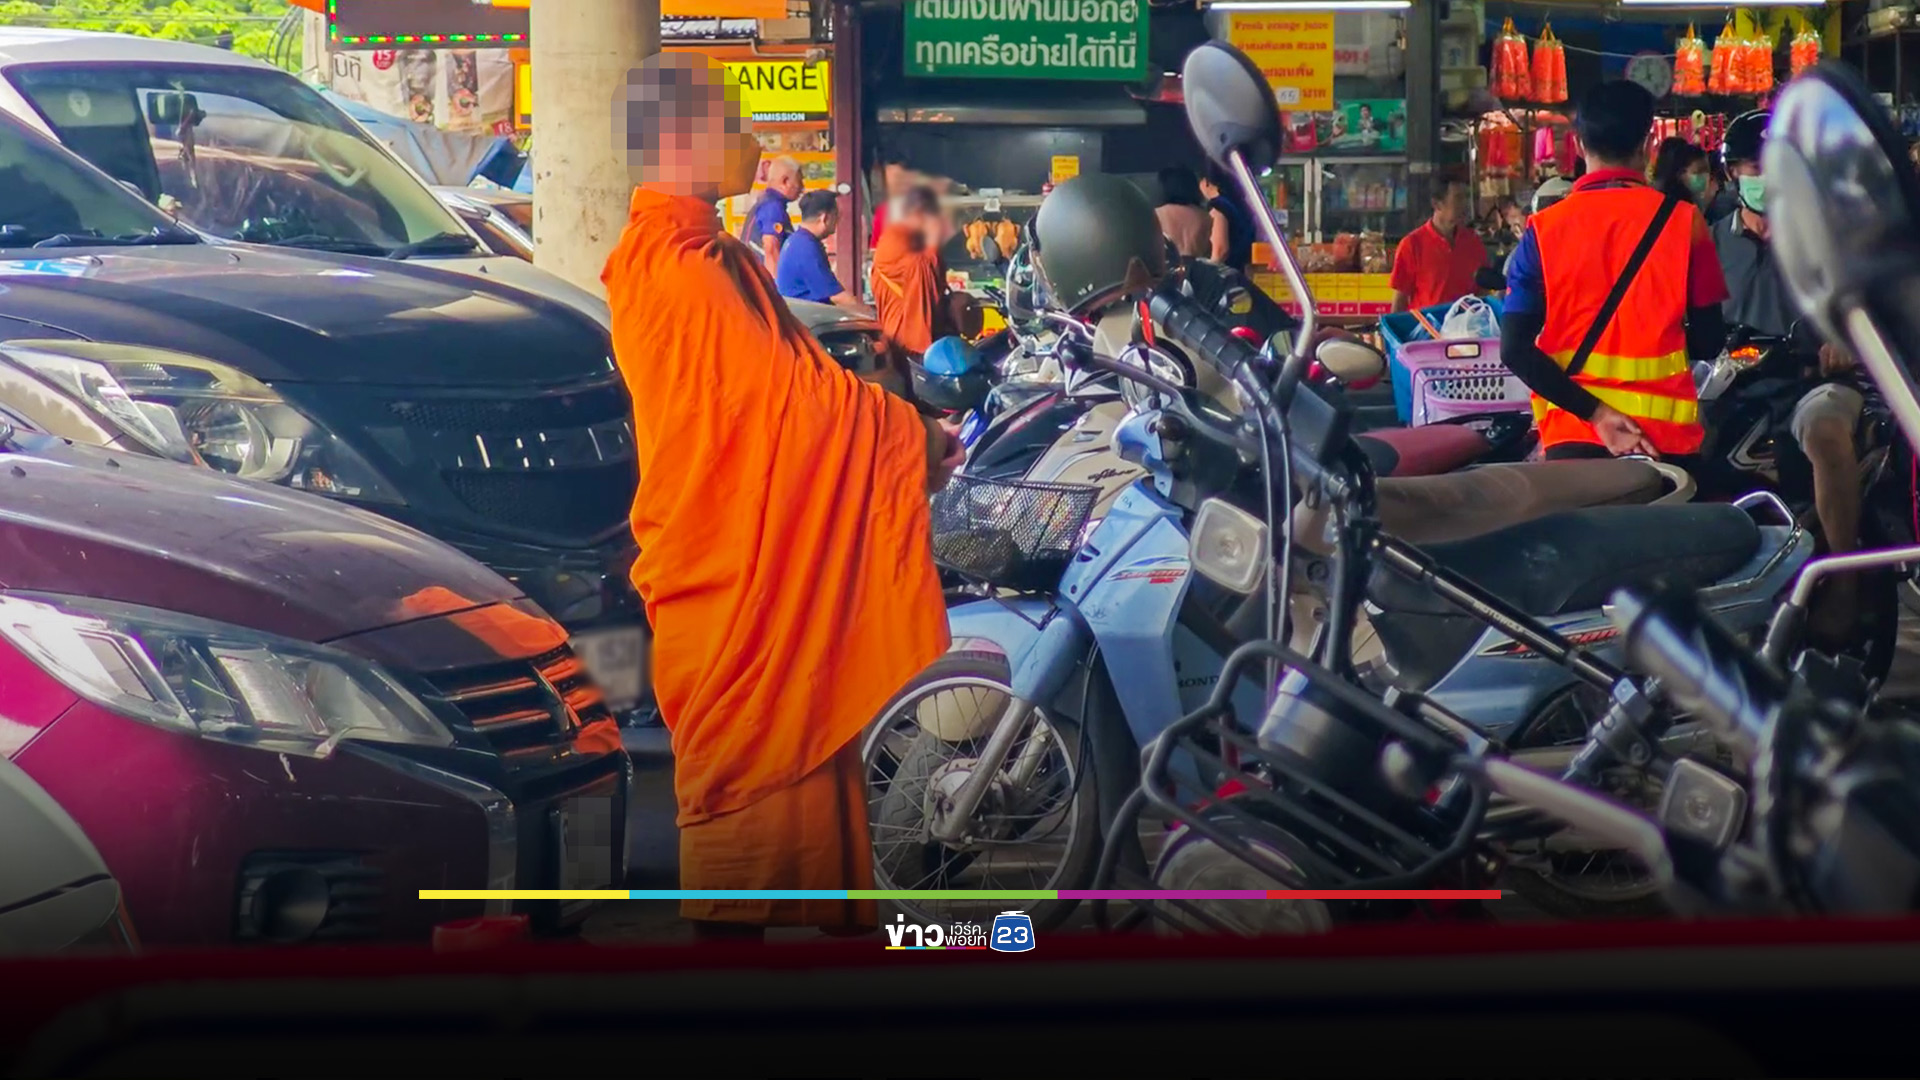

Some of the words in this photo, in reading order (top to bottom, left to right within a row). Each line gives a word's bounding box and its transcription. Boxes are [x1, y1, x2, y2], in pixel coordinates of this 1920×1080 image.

[915, 31, 1137, 73] ทุกเครือข่ายได้ที่นี่
